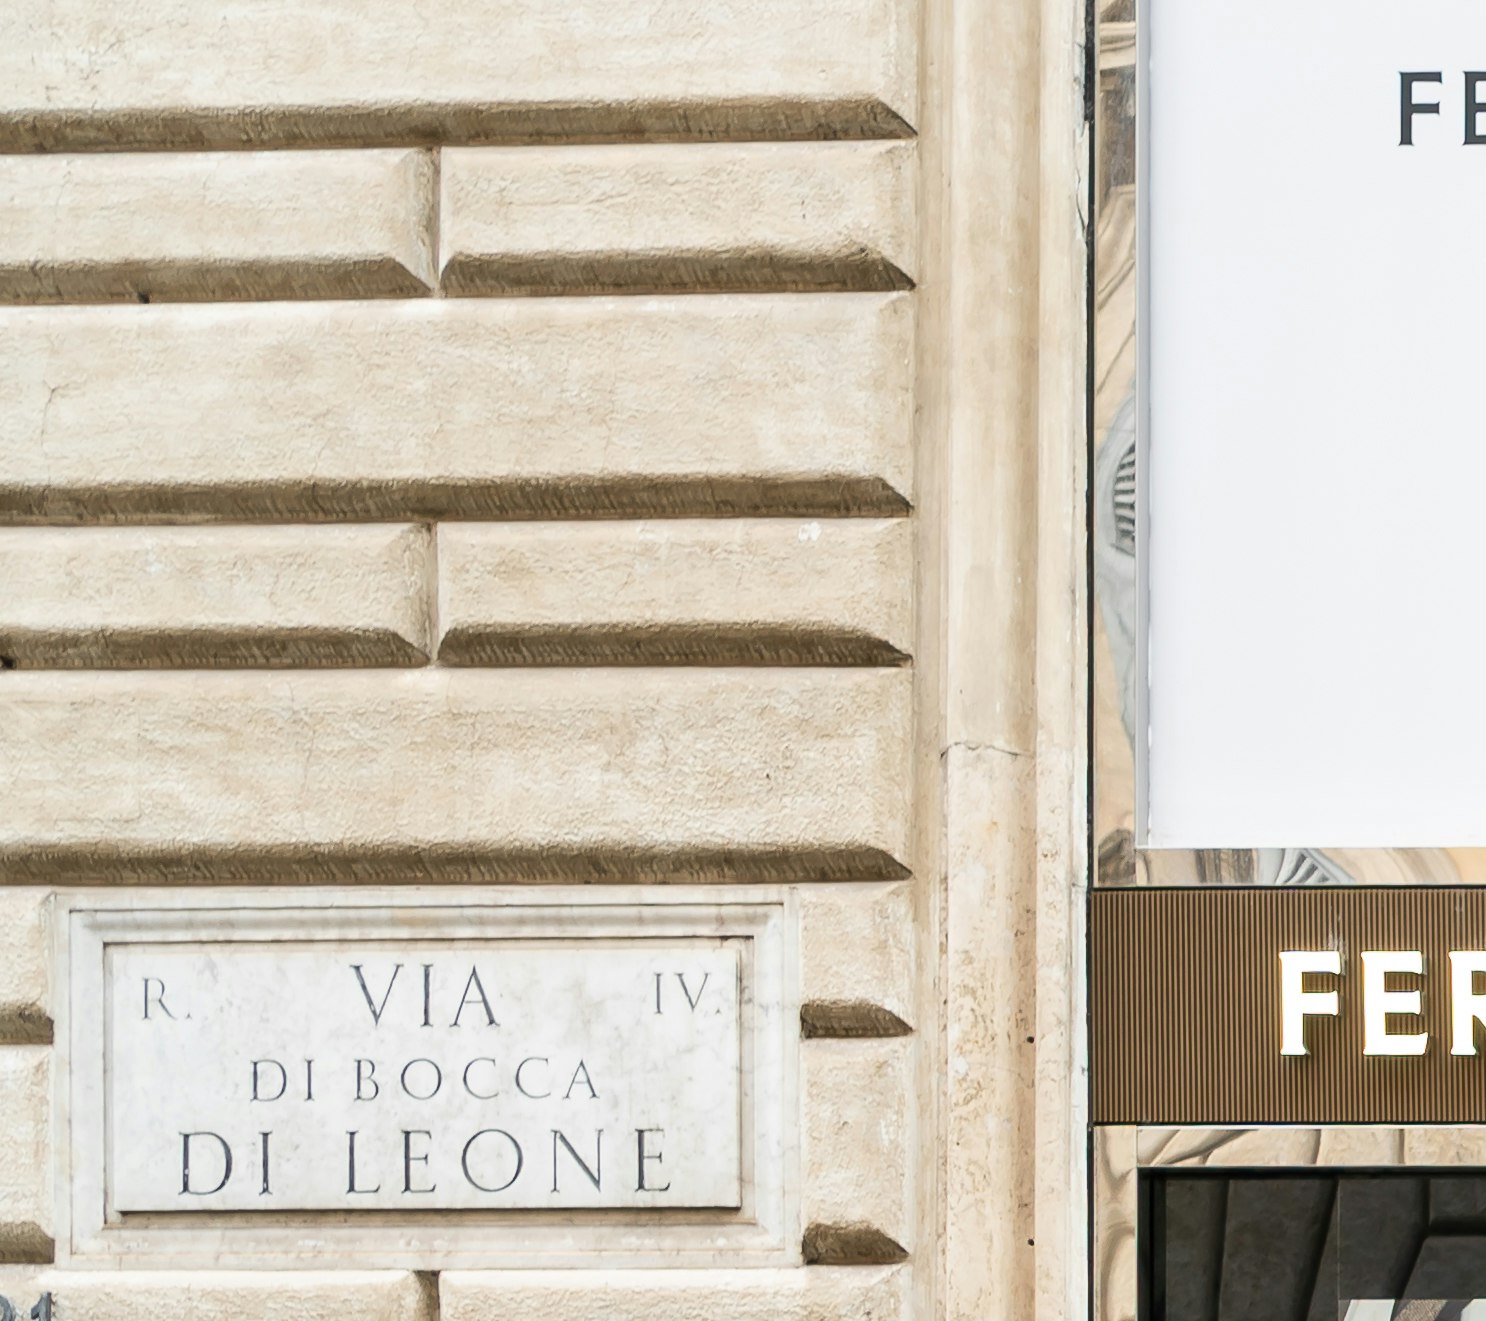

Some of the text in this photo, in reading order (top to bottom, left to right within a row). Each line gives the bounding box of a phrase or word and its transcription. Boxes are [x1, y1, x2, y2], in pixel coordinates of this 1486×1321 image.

[349, 963, 501, 1028] VIA
[249, 1057, 600, 1102] DI BOCCA
[178, 1128, 671, 1195] DI LEONE
